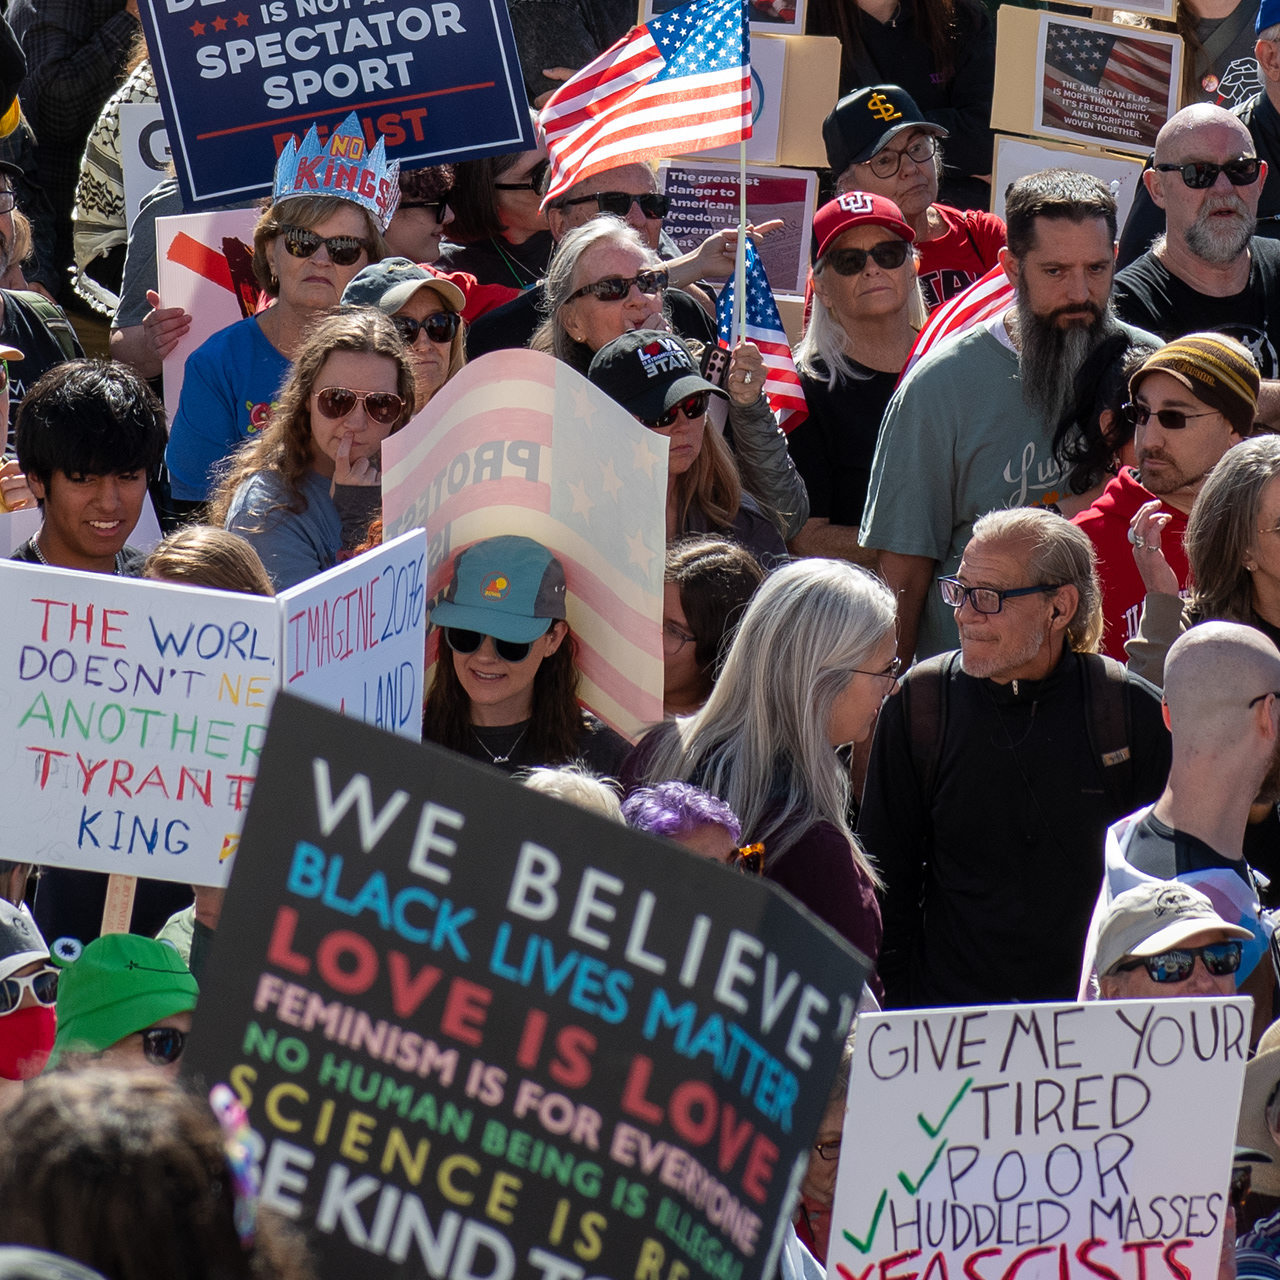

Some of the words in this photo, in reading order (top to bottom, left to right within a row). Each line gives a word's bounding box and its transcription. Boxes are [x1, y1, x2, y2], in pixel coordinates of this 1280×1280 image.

[260, 2, 289, 24] IS
[196, 2, 467, 79] SPECTATOR
[263, 51, 415, 110] SPORT
[1062, 81, 1079, 89] THE
[1080, 83, 1125, 99] AMERICAN
[1127, 94, 1150, 104] FLAG
[1064, 91, 1087, 100] MORE
[1090, 96, 1113, 106] THAN
[1062, 99, 1077, 108] IT'S
[1079, 102, 1122, 116] FREEDOM,
[1124, 111, 1151, 122] UNITY,
[1064, 117, 1094, 129] WOVEN
[1097, 124, 1142, 138] TOGETHER.
[1072, 110, 1090, 119] AND
[1092, 114, 1135, 128] SACRIFICE
[329, 133, 363, 160] NO
[668, 186, 718, 197] danger
[720, 188, 736, 197] to
[670, 172, 696, 181] The
[667, 211, 726, 223] freedom
[670, 199, 734, 210] American
[30, 598, 130, 650] THE
[288, 576, 380, 683] IMAGINE
[19, 645, 206, 696] DOESN'T
[76, 805, 191, 855] KING
[312, 757, 465, 884] WE
[286, 841, 478, 963] BLACK
[490, 922, 634, 1025] LIVES
[642, 987, 801, 1133] MATTER
[254, 972, 460, 1087] FEMINISM
[466, 1057, 507, 1106] IS
[513, 1078, 603, 1153] FOR
[266, 905, 494, 1048] LOVE
[517, 1009, 598, 1090] IS
[622, 1055, 781, 1205] LOVE
[867, 1011, 988, 1081] GIVE
[999, 1007, 1085, 1073] ME
[1116, 1003, 1244, 1069] YOUR
[242, 1021, 311, 1074] NO
[318, 1053, 472, 1144] HUMAN
[481, 1119, 605, 1199] BEING
[612, 1176, 647, 1220] IS
[971, 1074, 1151, 1140] TIRED
[229, 1064, 524, 1225] SCIENCE
[548, 1198, 610, 1262] IS
[947, 1133, 1135, 1202] POOR
[890, 1198, 1070, 1251] HUDDLED
[1090, 1192, 1223, 1245] MASSES
